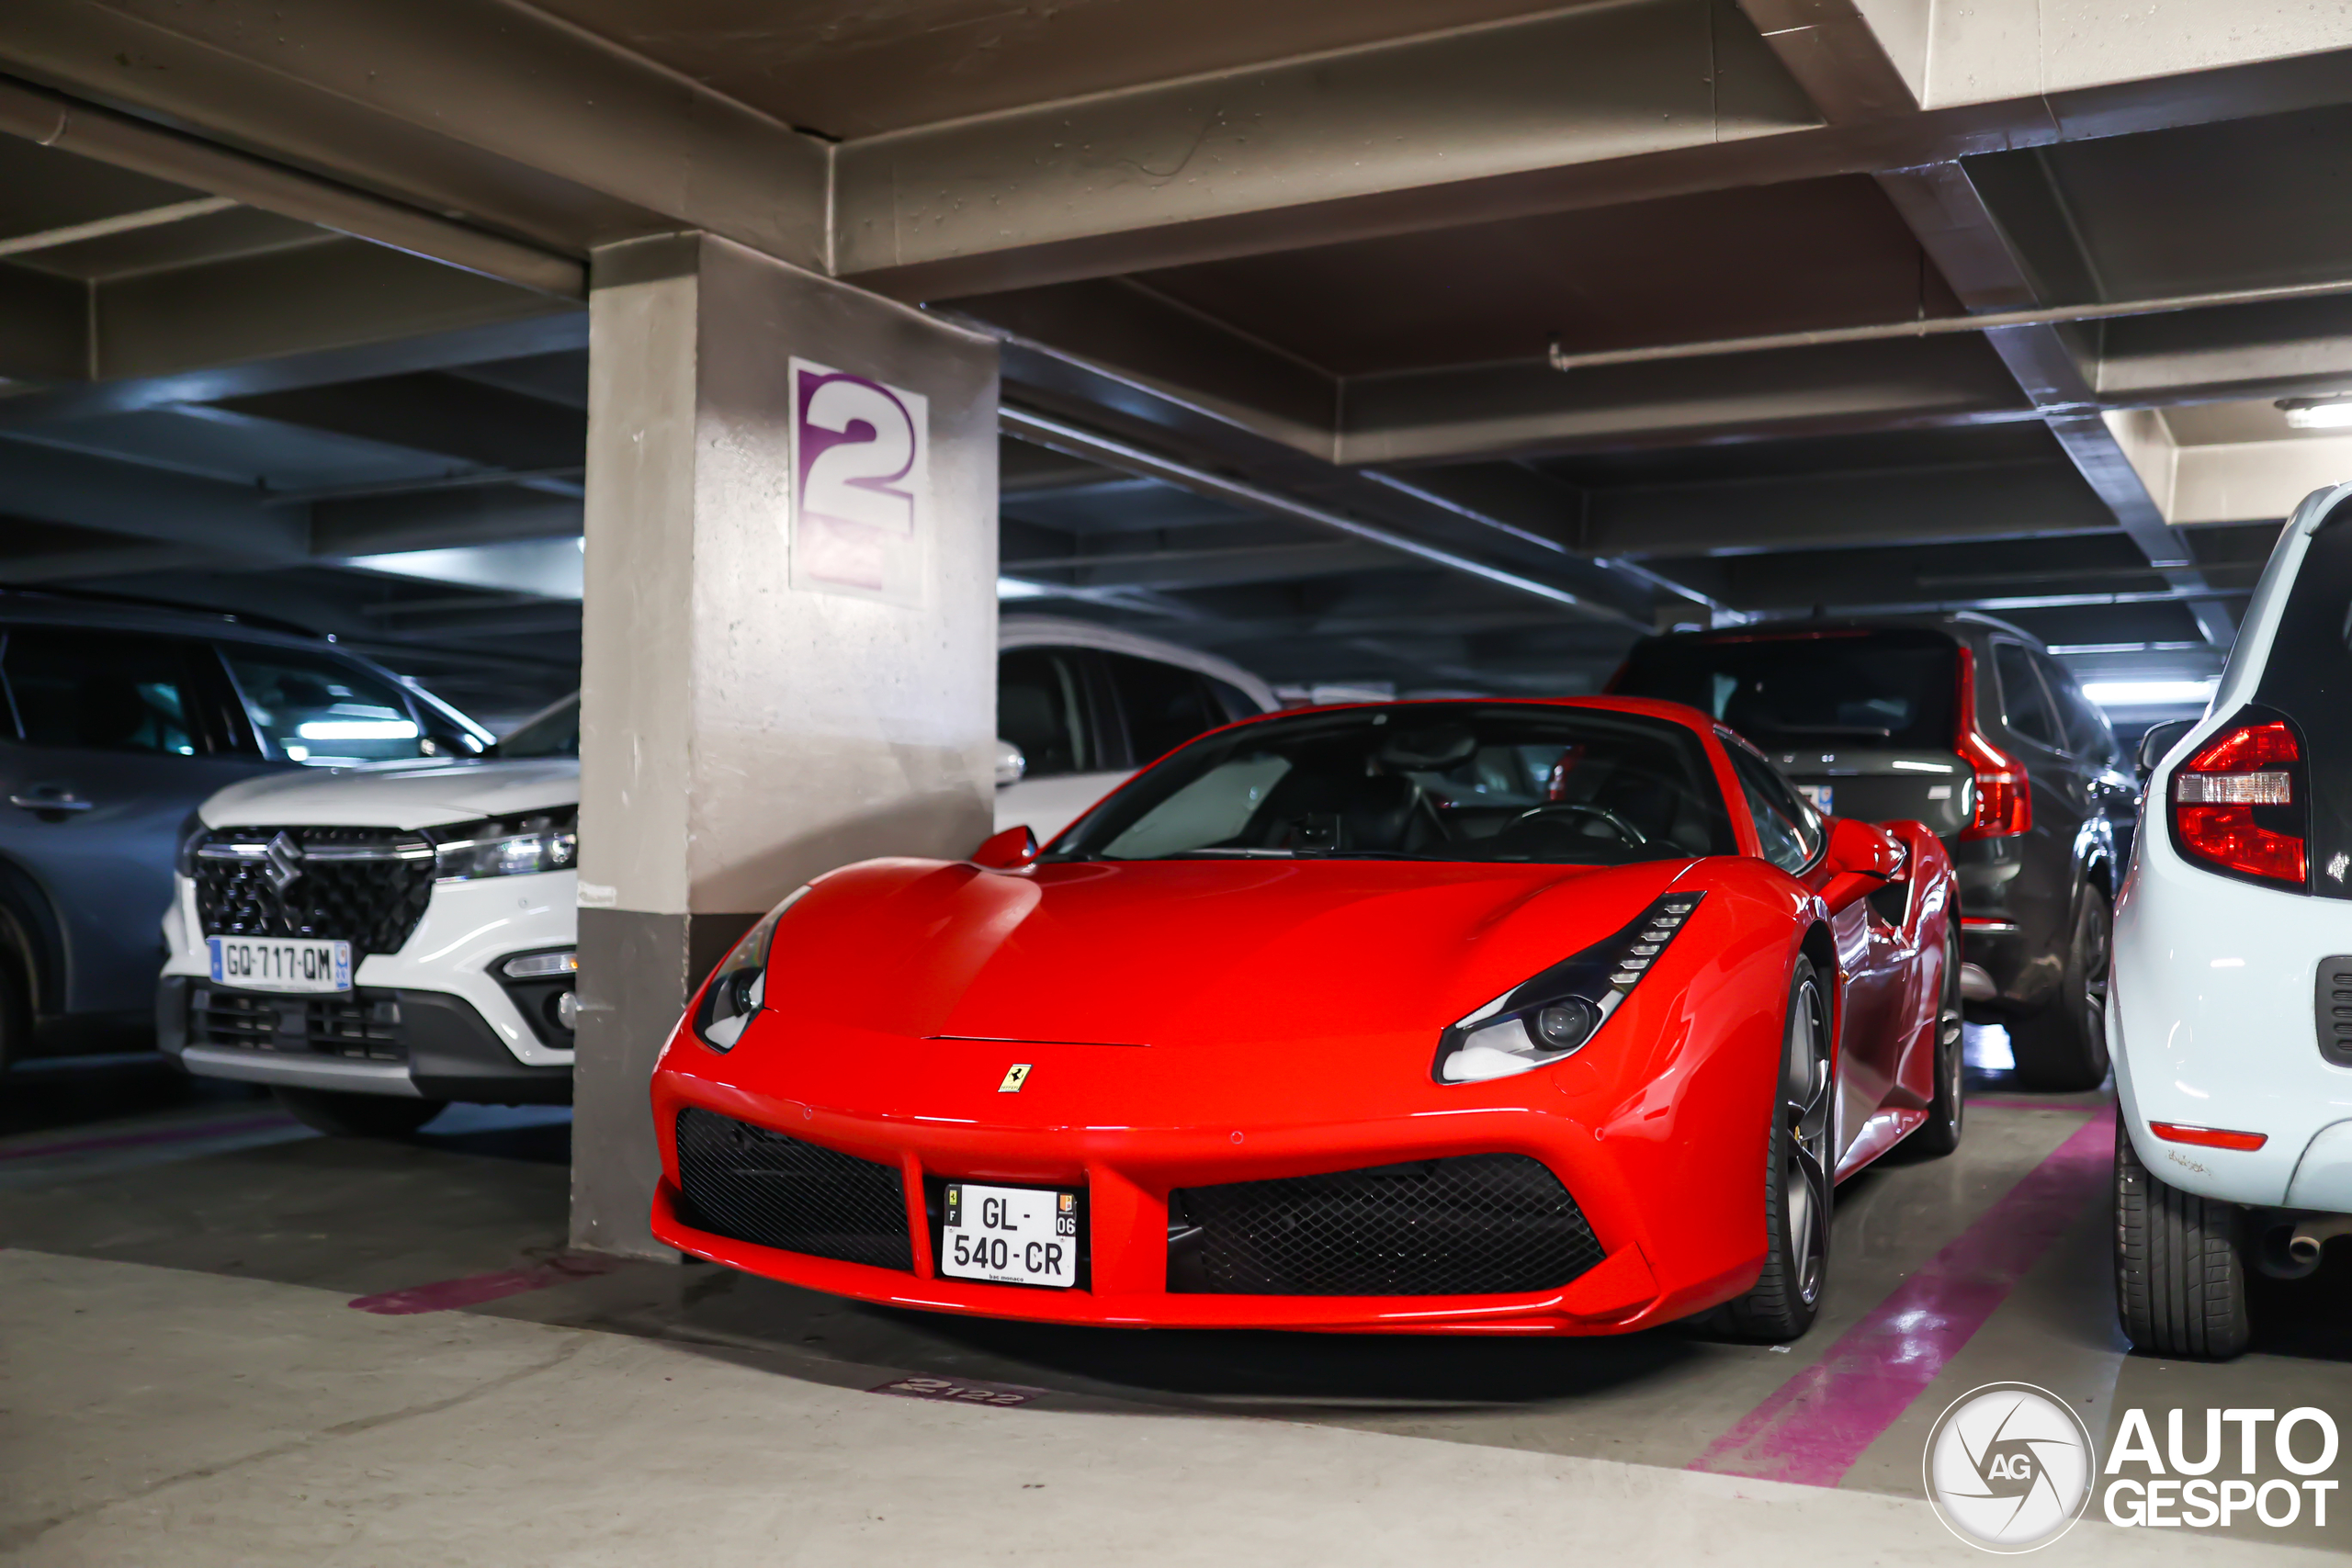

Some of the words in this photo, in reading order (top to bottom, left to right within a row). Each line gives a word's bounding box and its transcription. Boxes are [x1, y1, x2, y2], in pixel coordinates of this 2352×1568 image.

[802, 375, 914, 536] 2
[227, 944, 331, 981] GQ-717-QM
[949, 1210, 956, 1222] F
[1057, 1217, 1076, 1235] 06
